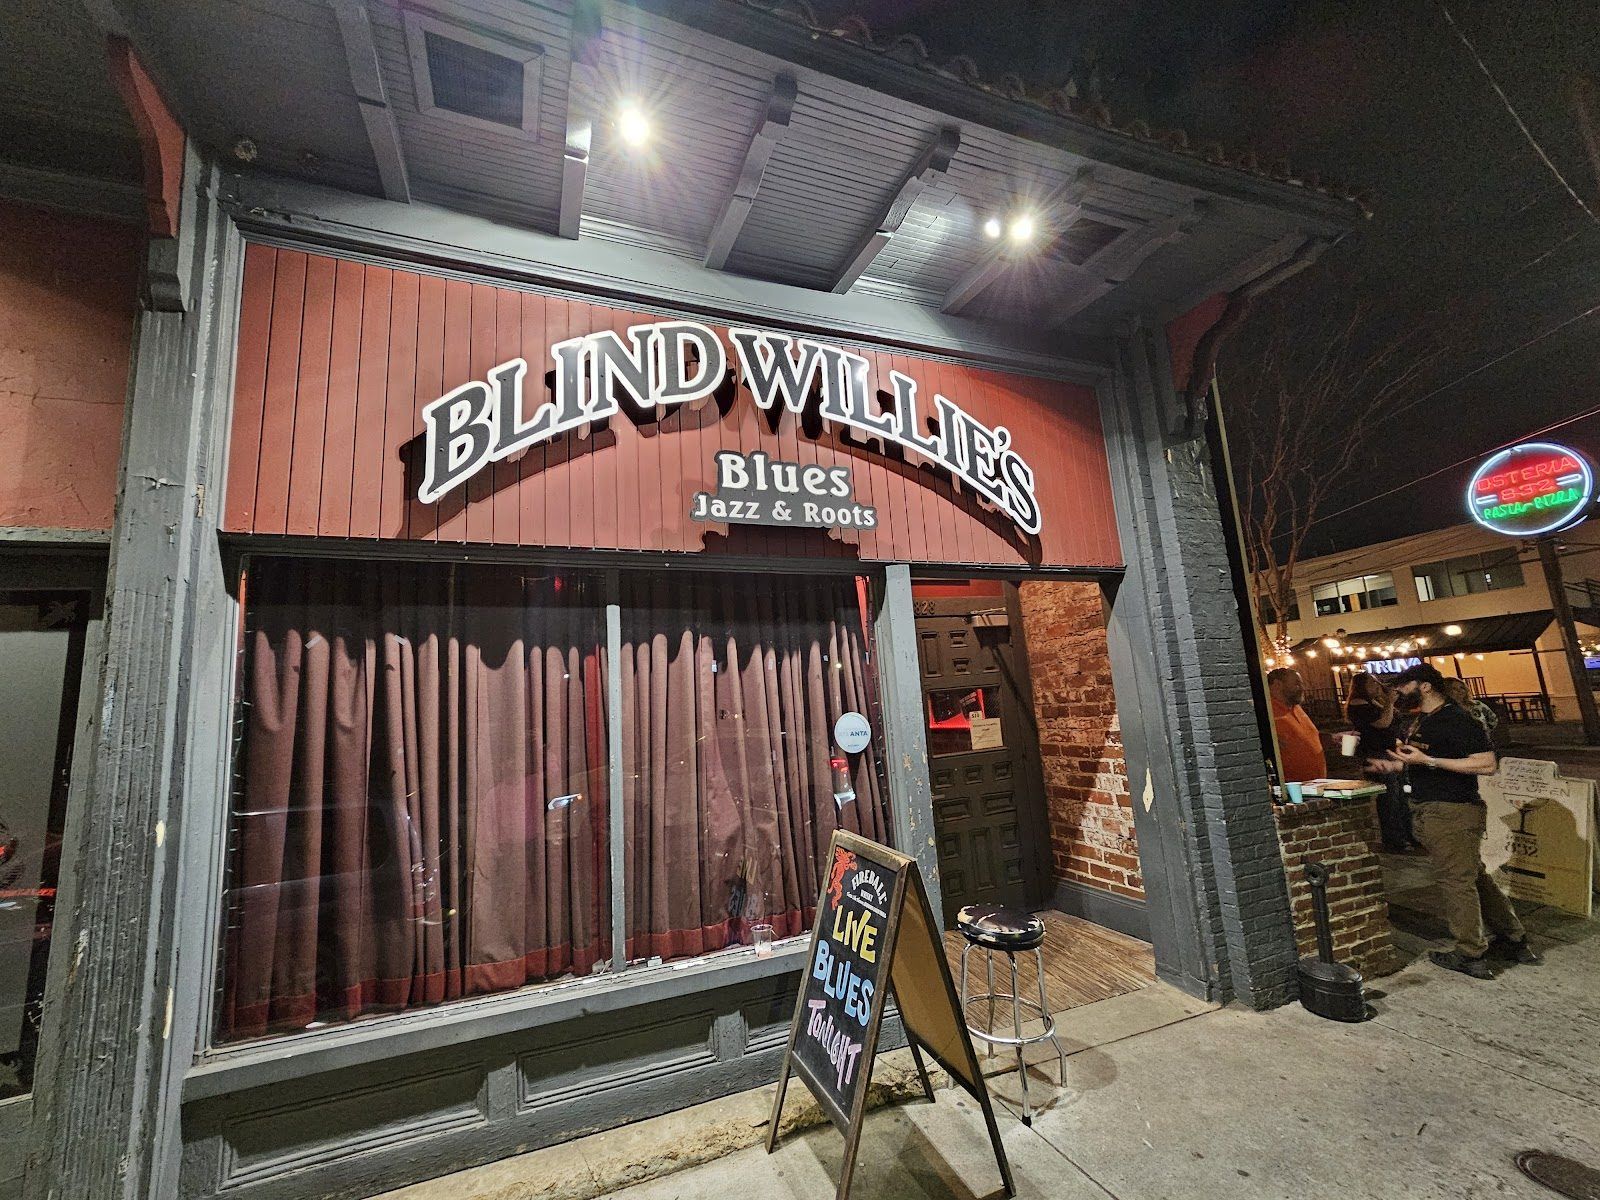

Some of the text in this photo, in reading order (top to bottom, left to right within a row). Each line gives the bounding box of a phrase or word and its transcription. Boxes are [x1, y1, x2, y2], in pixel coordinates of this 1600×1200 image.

[418, 321, 1041, 535] BLIND WILLIE'S
[719, 454, 849, 497] Blues
[1476, 457, 1577, 491] OSTERIA
[1501, 479, 1554, 500] 832
[694, 495, 875, 526] Jazz & Roots
[832, 905, 877, 963] LIVE
[813, 940, 874, 1027] BLUES
